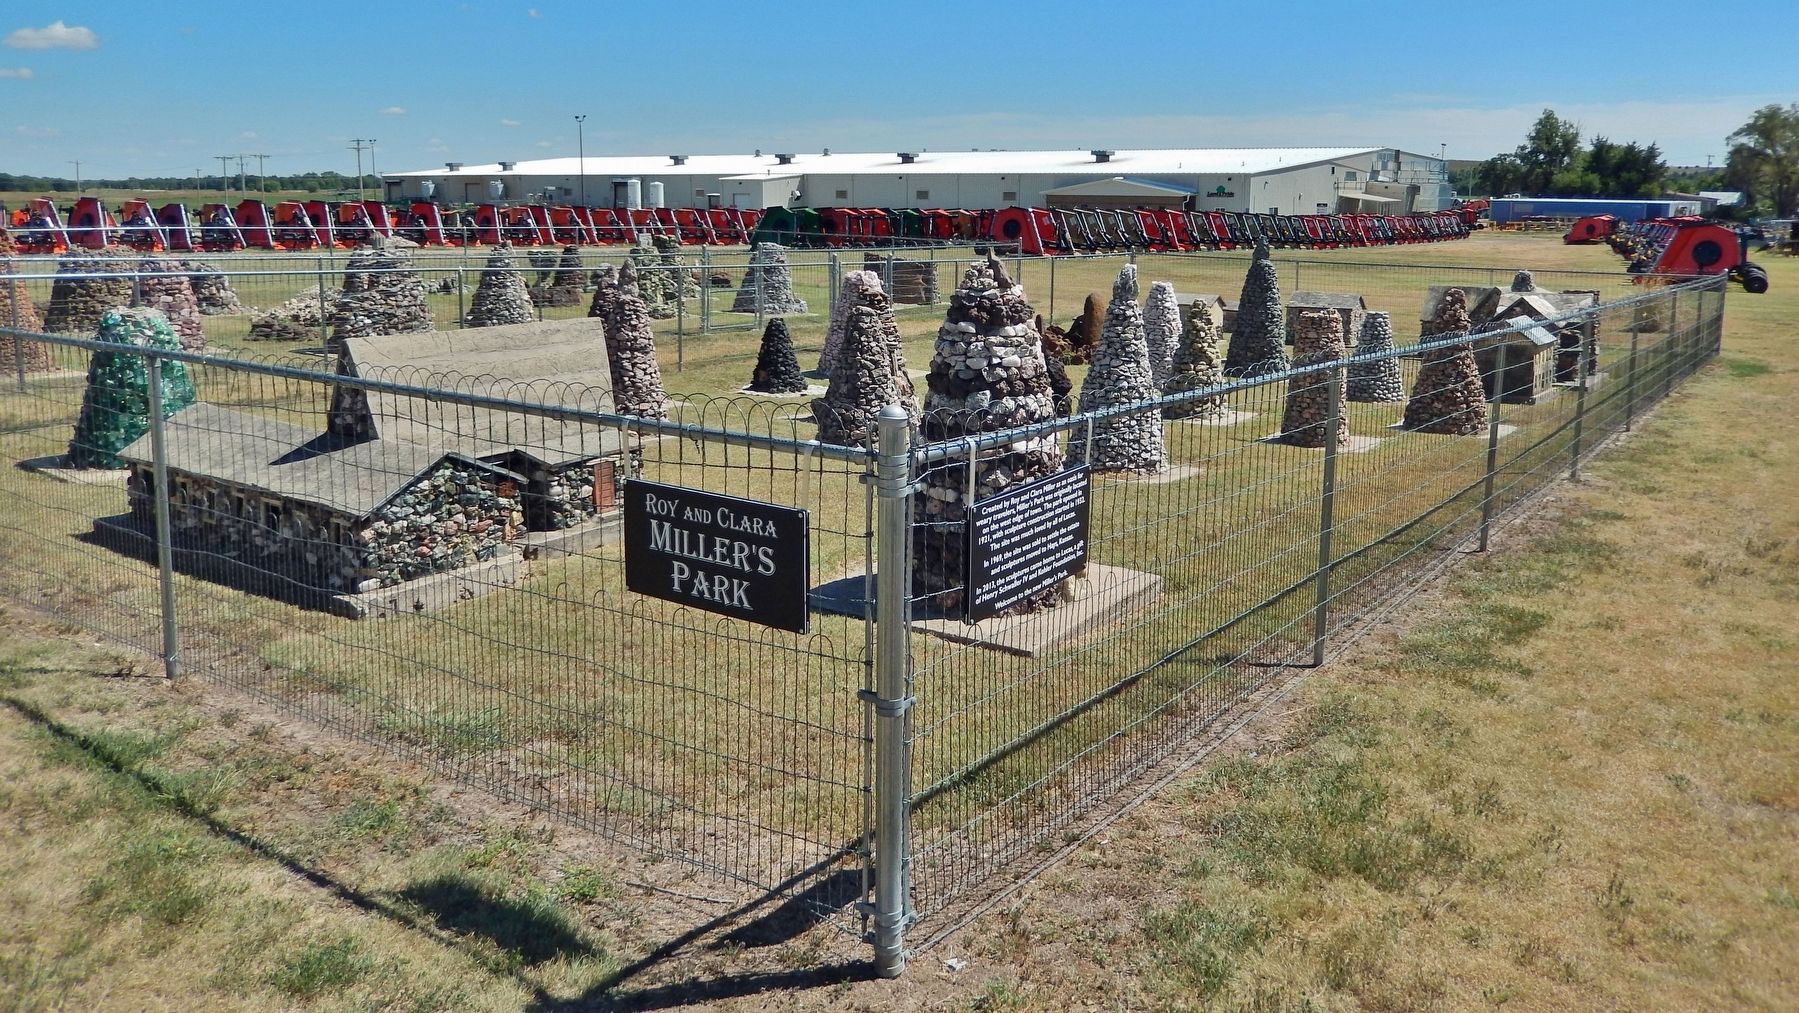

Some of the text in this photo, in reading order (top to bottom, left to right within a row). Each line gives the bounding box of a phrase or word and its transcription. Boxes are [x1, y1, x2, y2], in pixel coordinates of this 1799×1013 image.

[645, 493, 778, 538] ROY AND CLARA
[975, 516, 993, 527] weary
[1016, 499, 1033, 513] Miller's
[1033, 495, 1044, 506] Park
[1044, 493, 1053, 501] was
[1072, 477, 1088, 490] located
[981, 501, 1003, 515] Created
[1003, 499, 1010, 509] by
[1010, 496, 1020, 505] Roy
[1020, 493, 1030, 502] and
[1029, 488, 1043, 498] Clara
[1042, 483, 1056, 493] Miller
[982, 526, 990, 534] on
[989, 522, 999, 531] the
[999, 517, 1012, 528] west
[1011, 513, 1024, 523] edge
[1023, 509, 1030, 518] of
[1042, 502, 1052, 510] The
[1052, 497, 1063, 509] park
[1077, 489, 1083, 498] in
[989, 542, 1001, 551] The
[1000, 538, 1010, 547] site
[1010, 534, 1020, 543] was
[1020, 527, 1034, 539] much
[1034, 521, 1047, 534] loved
[1046, 520, 1052, 529] by
[1058, 514, 1064, 523] of
[991, 529, 1004, 540] with
[1004, 522, 1027, 536] sculpture
[1026, 510, 1055, 526] construction
[1054, 501, 1070, 515] started
[650, 519, 776, 576] MILLER'S
[983, 559, 989, 568] In
[1003, 551, 1012, 560] the
[1012, 547, 1022, 556] site
[1021, 543, 1031, 552] was
[1031, 536, 1041, 548] sold
[1059, 527, 1067, 535] the
[1066, 521, 1080, 532] estate
[990, 564, 1001, 576] and
[1000, 555, 1026, 571] sculptures
[1025, 546, 1041, 560] moved
[671, 560, 754, 611] PARK
[975, 587, 982, 595] In
[996, 577, 1005, 586] the
[1005, 566, 1030, 583] sculptures
[1029, 560, 1043, 571] came
[1042, 554, 1055, 565] home
[975, 595, 982, 605] of
[981, 589, 999, 602] Henry
[1022, 574, 1029, 584] IV
[1028, 569, 1038, 581] and
[994, 595, 1018, 610] Welcome
[1023, 588, 1032, 596] the
[1032, 583, 1042, 593] new
[1041, 574, 1057, 588] Miller's
